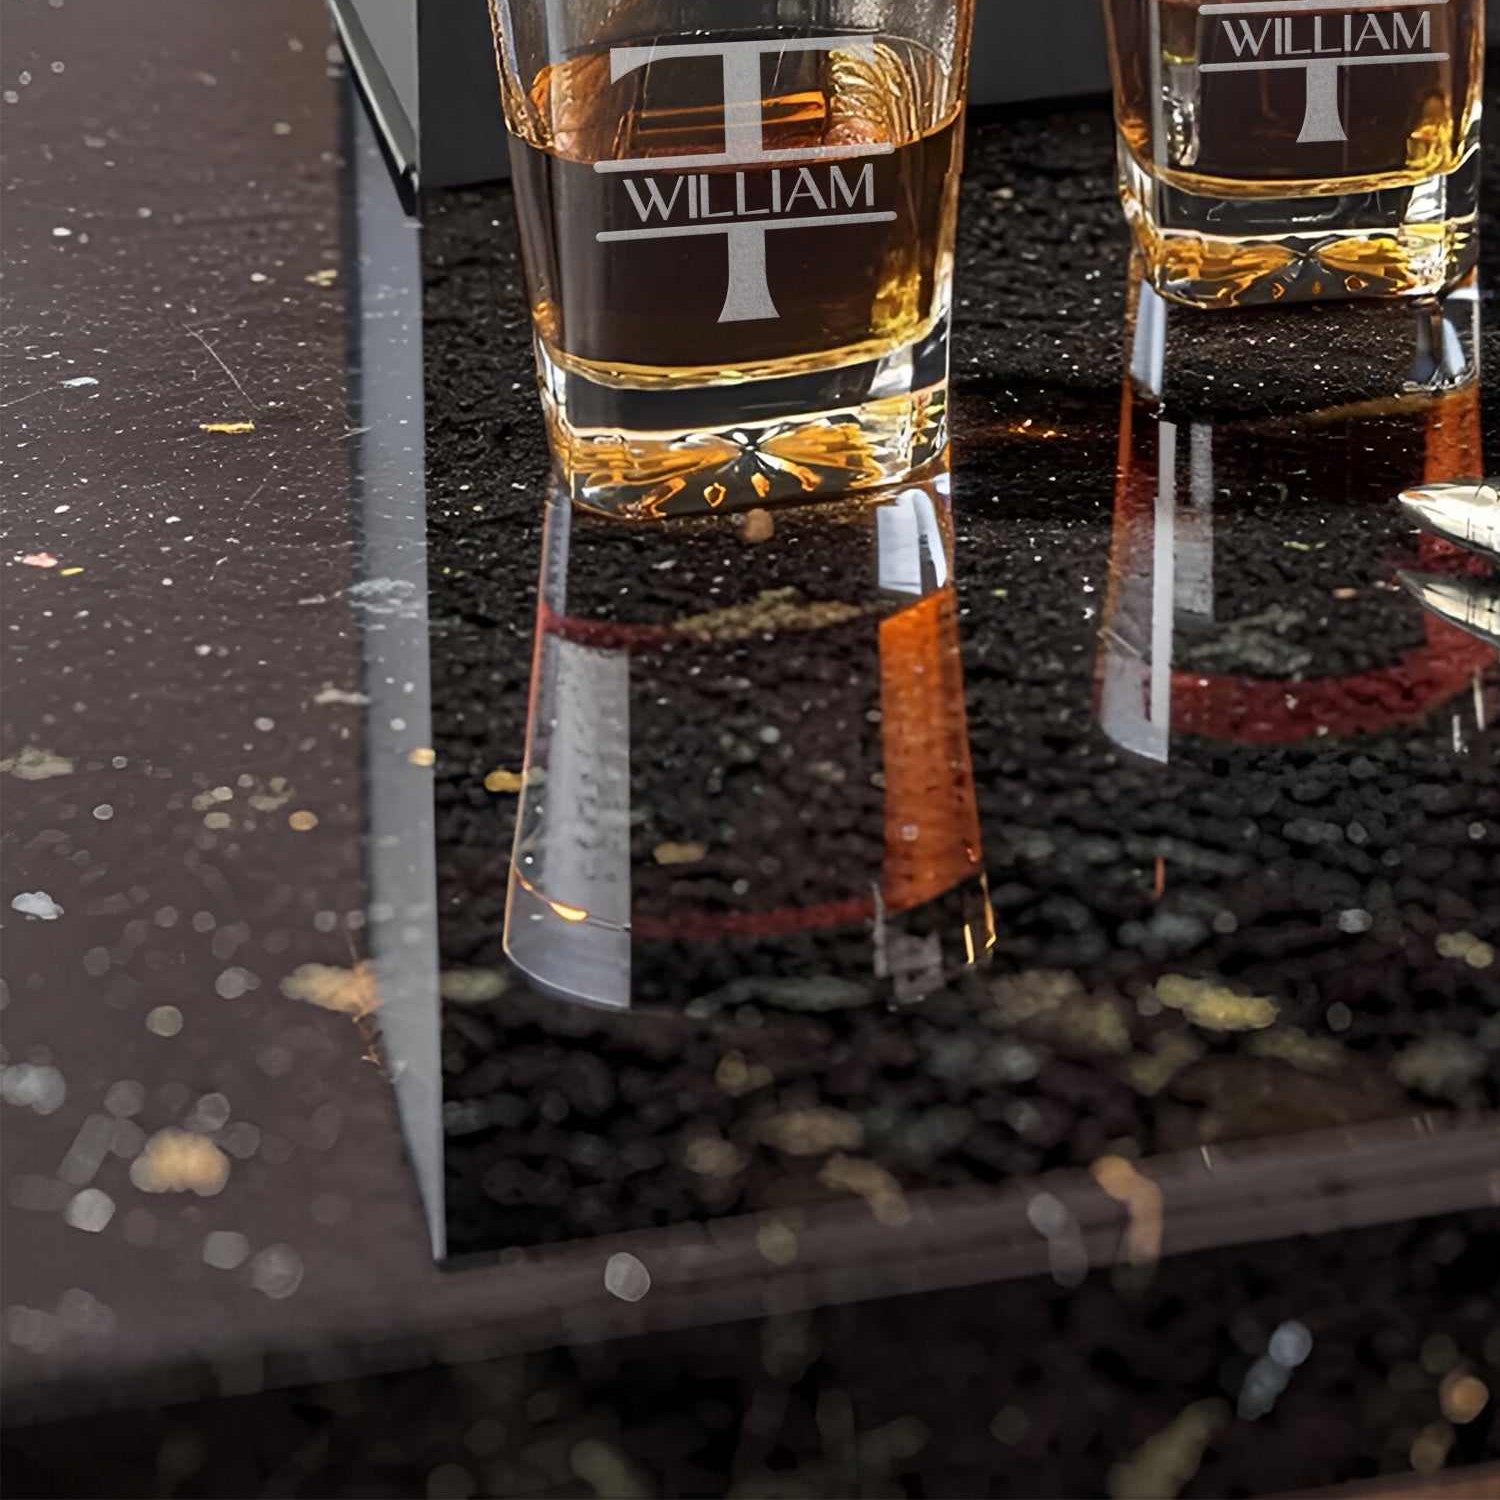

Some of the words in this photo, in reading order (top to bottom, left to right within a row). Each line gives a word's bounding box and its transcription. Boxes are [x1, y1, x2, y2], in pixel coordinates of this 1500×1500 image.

[1221, 10, 1432, 58] WILLIAM
[609, 35, 876, 324] T
[622, 162, 876, 223] WILLIAM
